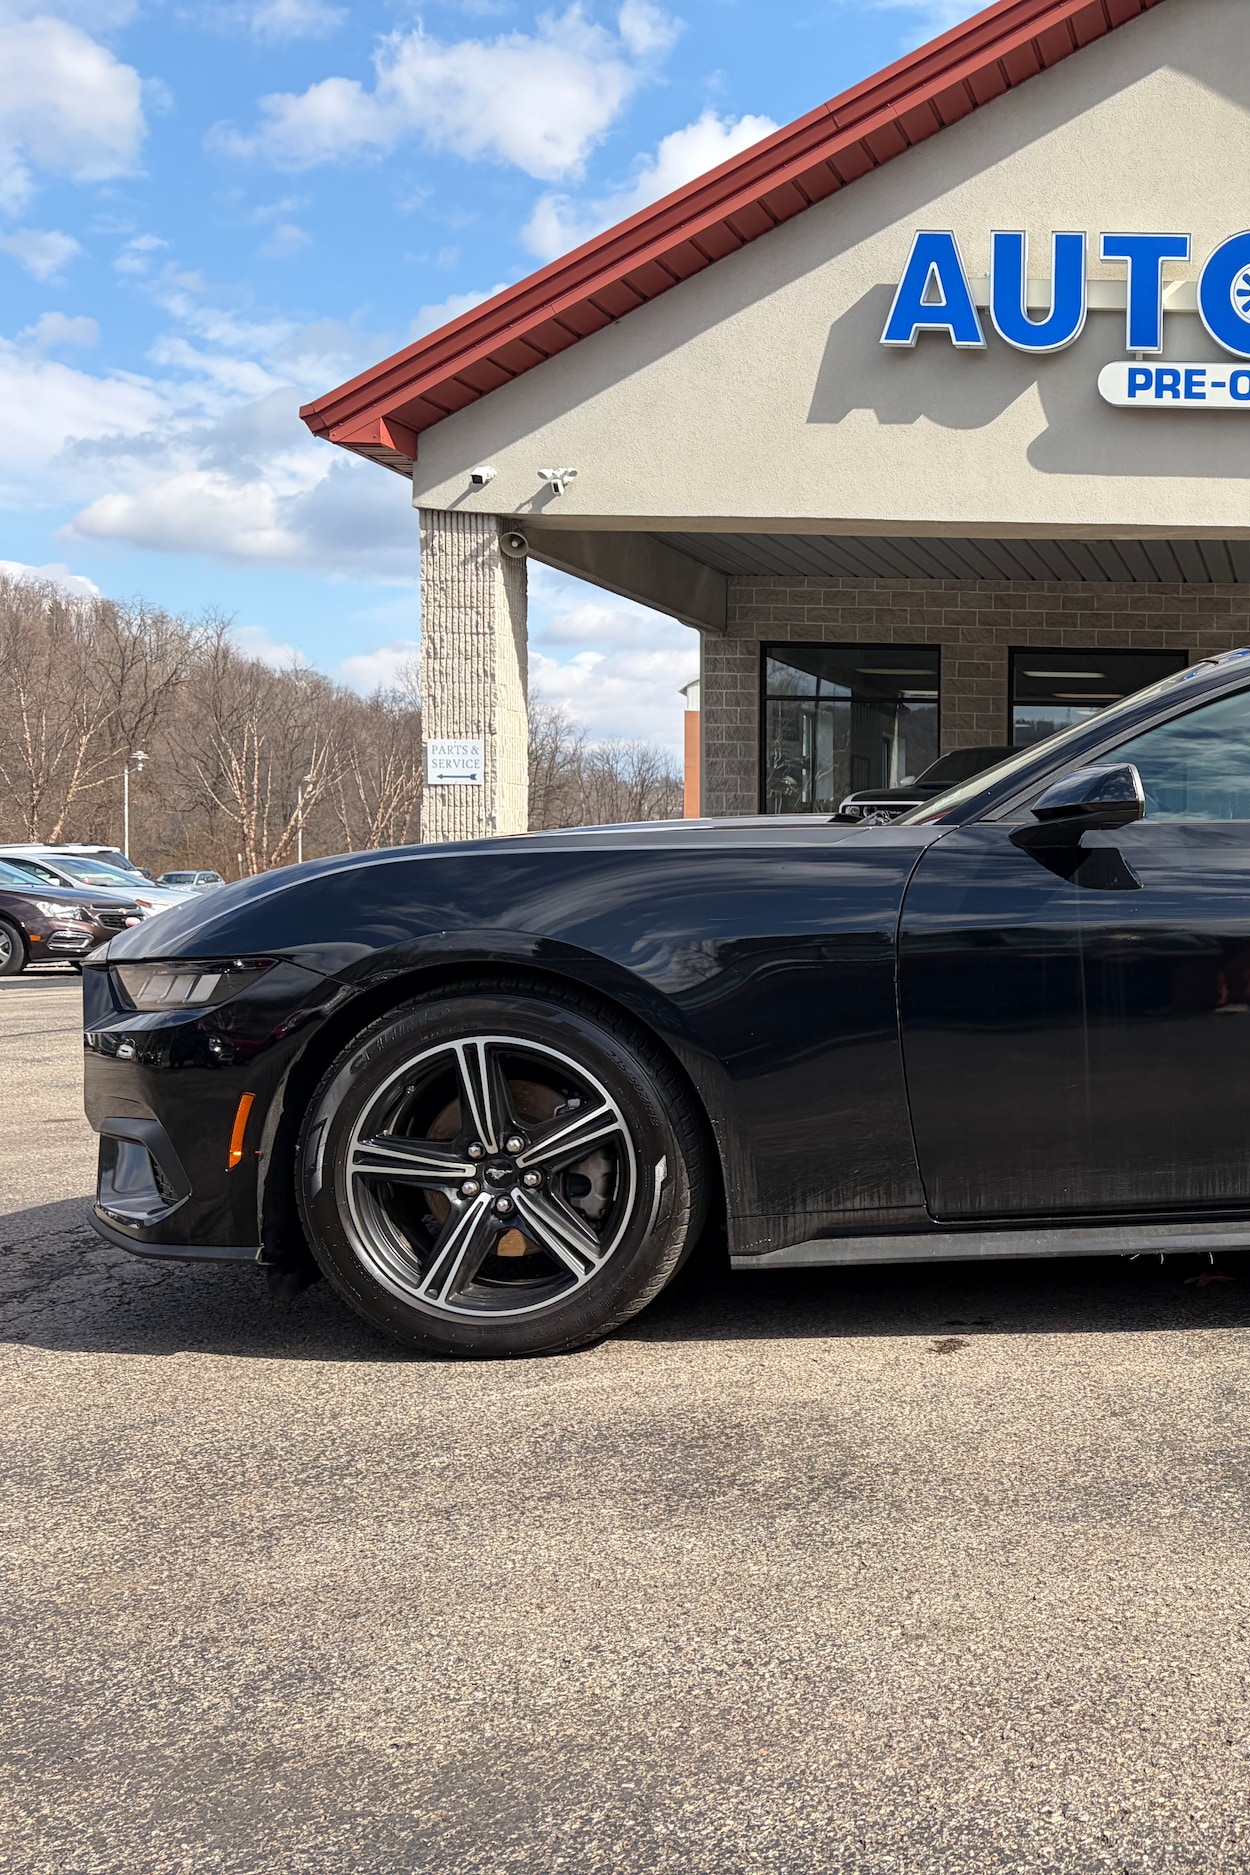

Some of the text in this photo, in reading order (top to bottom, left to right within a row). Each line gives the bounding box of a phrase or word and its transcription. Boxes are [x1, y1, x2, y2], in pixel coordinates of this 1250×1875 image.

[431, 744, 480, 755] PARTS &
[431, 758, 480, 769] SERVICE
